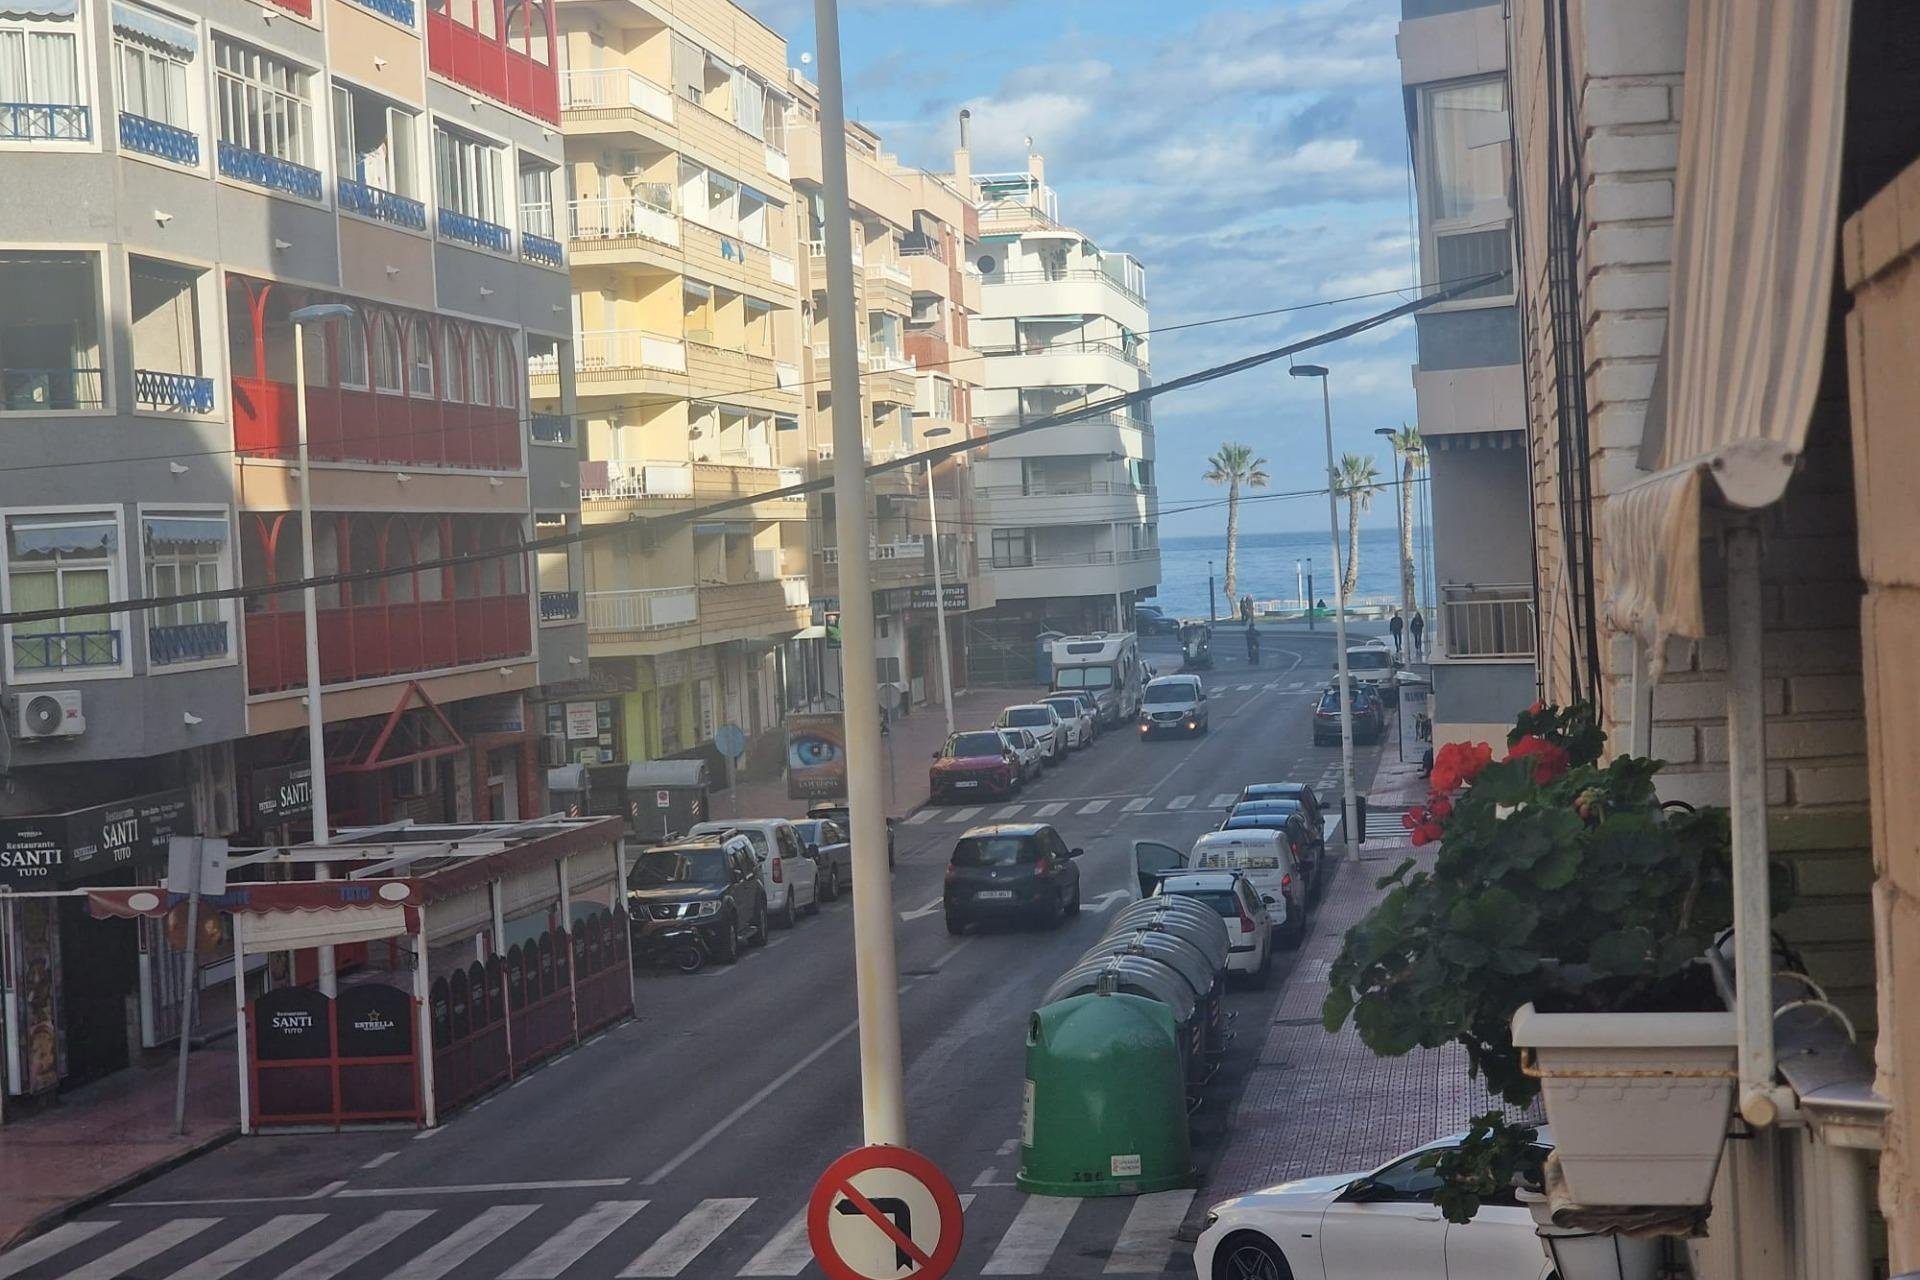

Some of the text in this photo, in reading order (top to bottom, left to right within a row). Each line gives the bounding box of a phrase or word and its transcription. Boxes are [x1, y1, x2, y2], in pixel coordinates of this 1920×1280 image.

[921, 588, 965, 597] maymas
[912, 600, 967, 608] SUPERRCADO
[280, 782, 308, 808] SANTI
[103, 819, 139, 849] SANTI
[6, 841, 55, 850] Restaurante
[0, 849, 63, 867] SANTI
[113, 846, 132, 862] TUTO
[17, 867, 47, 877] TUTO
[272, 1016, 313, 1028] SANTI
[354, 1020, 394, 1029] ESTRELLA
